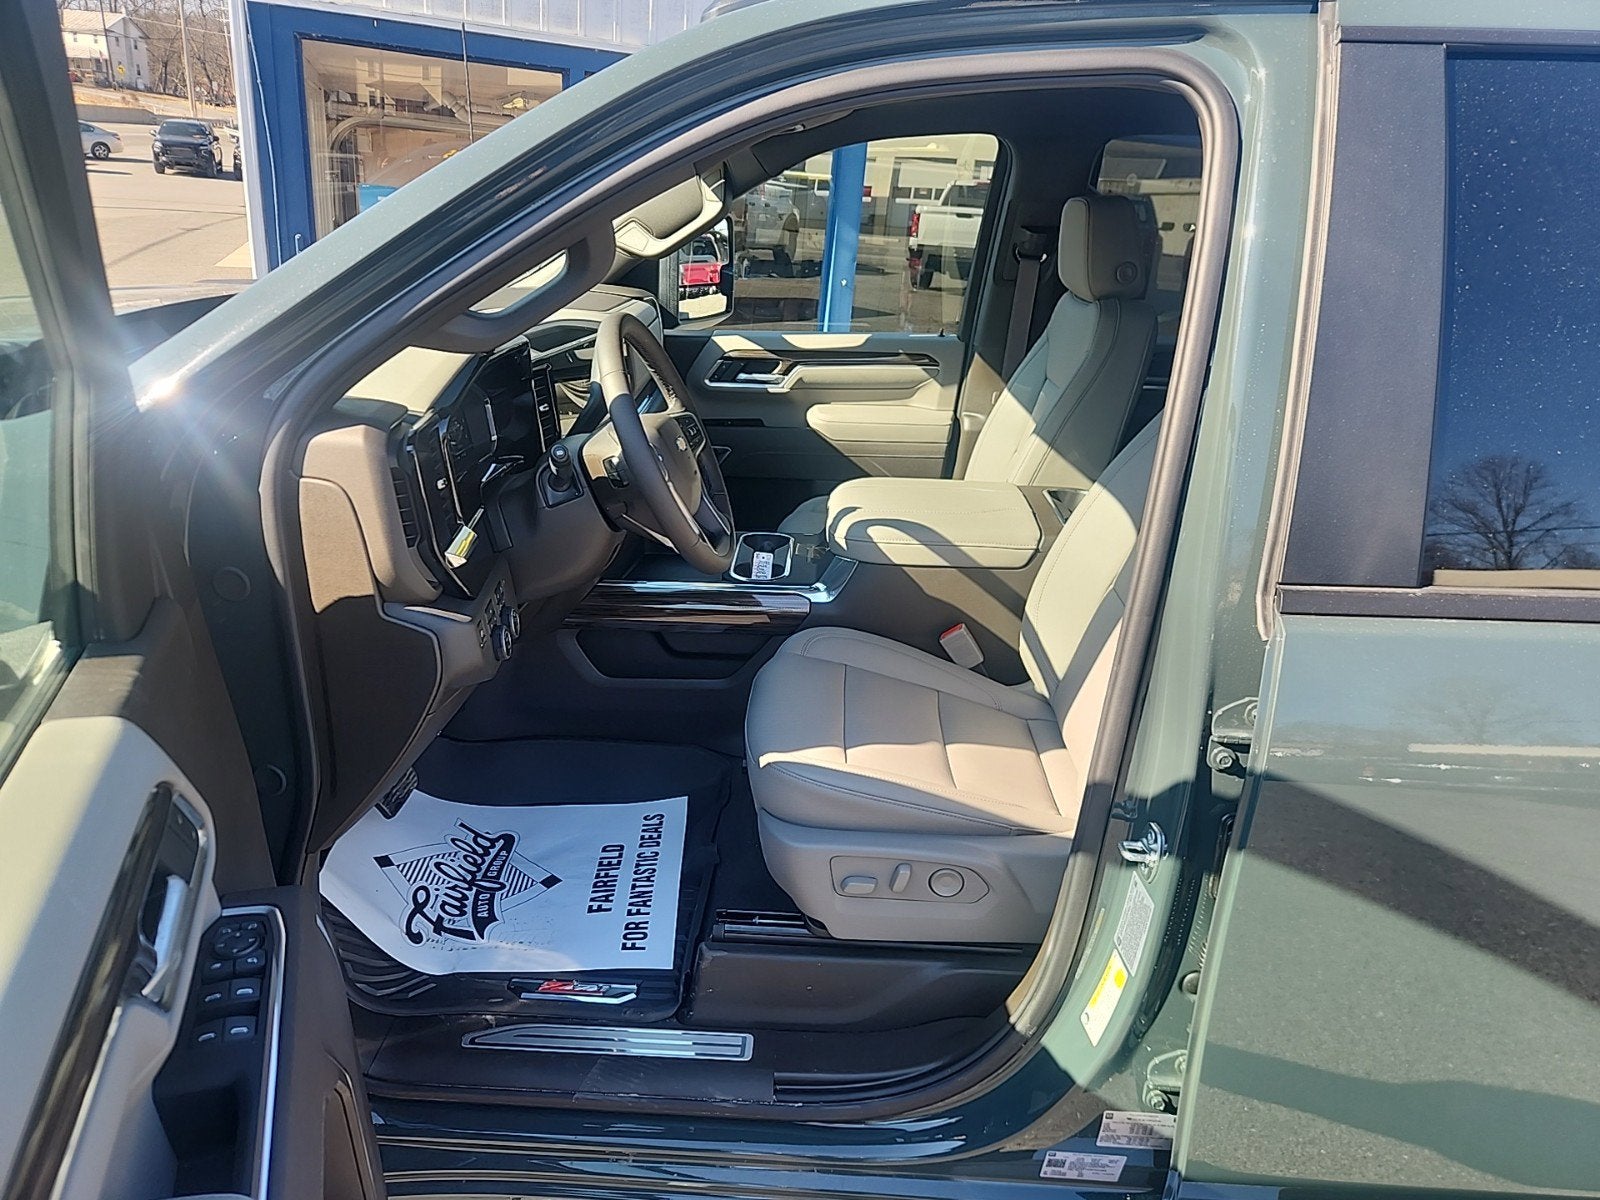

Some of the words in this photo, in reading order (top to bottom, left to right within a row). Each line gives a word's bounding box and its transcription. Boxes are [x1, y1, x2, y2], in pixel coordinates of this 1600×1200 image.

[640, 812, 666, 848] DEALS
[404, 820, 510, 944] Fairfield
[477, 893, 491, 917] AUTO
[487, 850, 508, 877] GROUP
[587, 844, 625, 915] FAIRFIELD
[627, 848, 660, 917] FANTASTIC
[621, 919, 648, 951] FOR
